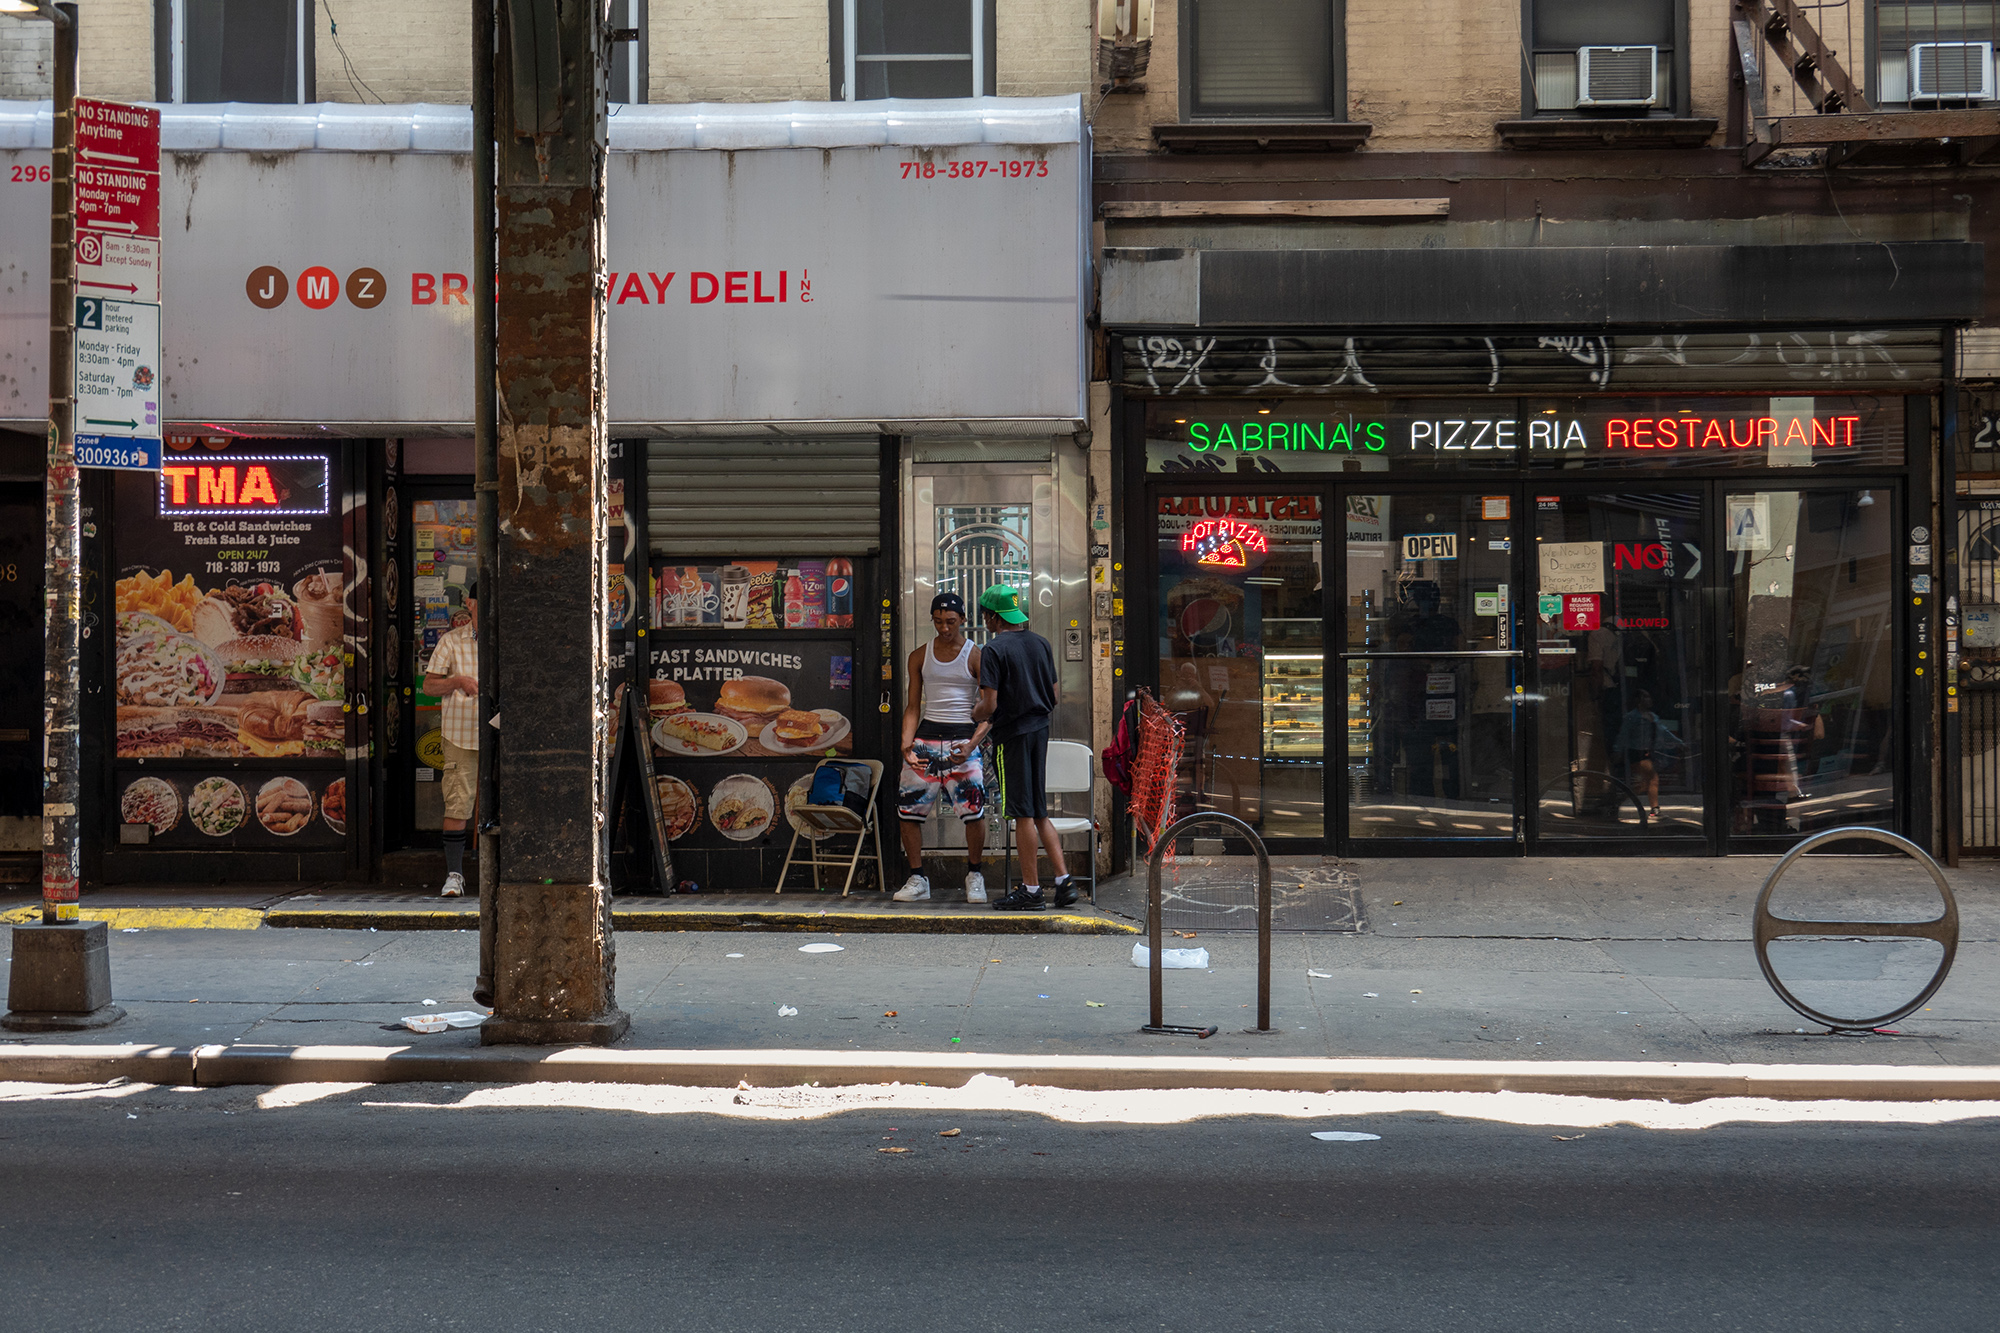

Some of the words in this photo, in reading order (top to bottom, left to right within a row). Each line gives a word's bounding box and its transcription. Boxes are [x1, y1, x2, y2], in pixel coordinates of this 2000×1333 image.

[79, 105, 94, 120] NO
[97, 109, 149, 128] STANDING
[79, 122, 123, 140] Anytime
[900, 160, 1049, 180] 718-387-1973
[79, 171, 94, 185] NO
[96, 173, 147, 190] STANDING
[79, 187, 110, 202] Monday
[117, 191, 141, 206] Friday
[79, 200, 97, 212] 4pm
[104, 202, 121, 215] 7pm
[106, 241, 120, 251] 8am
[105, 254, 127, 266] Except
[129, 257, 152, 268] Sunday
[258, 276, 276, 299] J
[306, 277, 330, 300] M
[358, 279, 375, 299] Z
[689, 271, 788, 304] DELI
[82, 300, 96, 327] 2
[105, 303, 120, 313] hour
[105, 313, 133, 324] metered
[105, 324, 130, 335] parking
[79, 340, 110, 354] Monday
[117, 343, 141, 357] Friday
[79, 353, 110, 365] 8:30am
[117, 357, 135, 368] 4pm
[79, 371, 115, 385] Saturday
[79, 384, 109, 396] 8:30am
[117, 387, 133, 398] 7pm
[77, 436, 100, 445] Zone#
[1188, 421, 1386, 452] SABRINA'S
[1606, 416, 1860, 449] RESTAURANT
[77, 447, 129, 466] 300936
[163, 466, 278, 504] TMA
[173, 521, 195, 532] Hot
[196, 521, 206, 532] &
[209, 521, 236, 532] Cold
[238, 521, 312, 532] Sandwiches
[1736, 508, 1761, 535] A
[185, 534, 216, 546] Fresh
[220, 534, 255, 546] Salad
[257, 534, 267, 546] &
[269, 534, 300, 546] Juice
[1182, 520, 1216, 551] HOT
[1218, 519, 1268, 553] PIZZA
[1406, 535, 1454, 558] OPEN
[217, 550, 244, 561] OPEN
[246, 550, 269, 561] 24/7
[1615, 543, 1666, 571] NO
[206, 561, 223, 574] 718
[230, 561, 250, 574] 387
[257, 561, 281, 574] 1973
[750, 574, 774, 587] eetos
[429, 596, 446, 604] PULL
[1616, 617, 1669, 628] ALLOWED
[1499, 616, 1507, 647] PUSH
[650, 649, 690, 665] FAST
[694, 649, 802, 670] SANDWICHES
[656, 667, 669, 681] &
[673, 667, 744, 682] PLATTER
